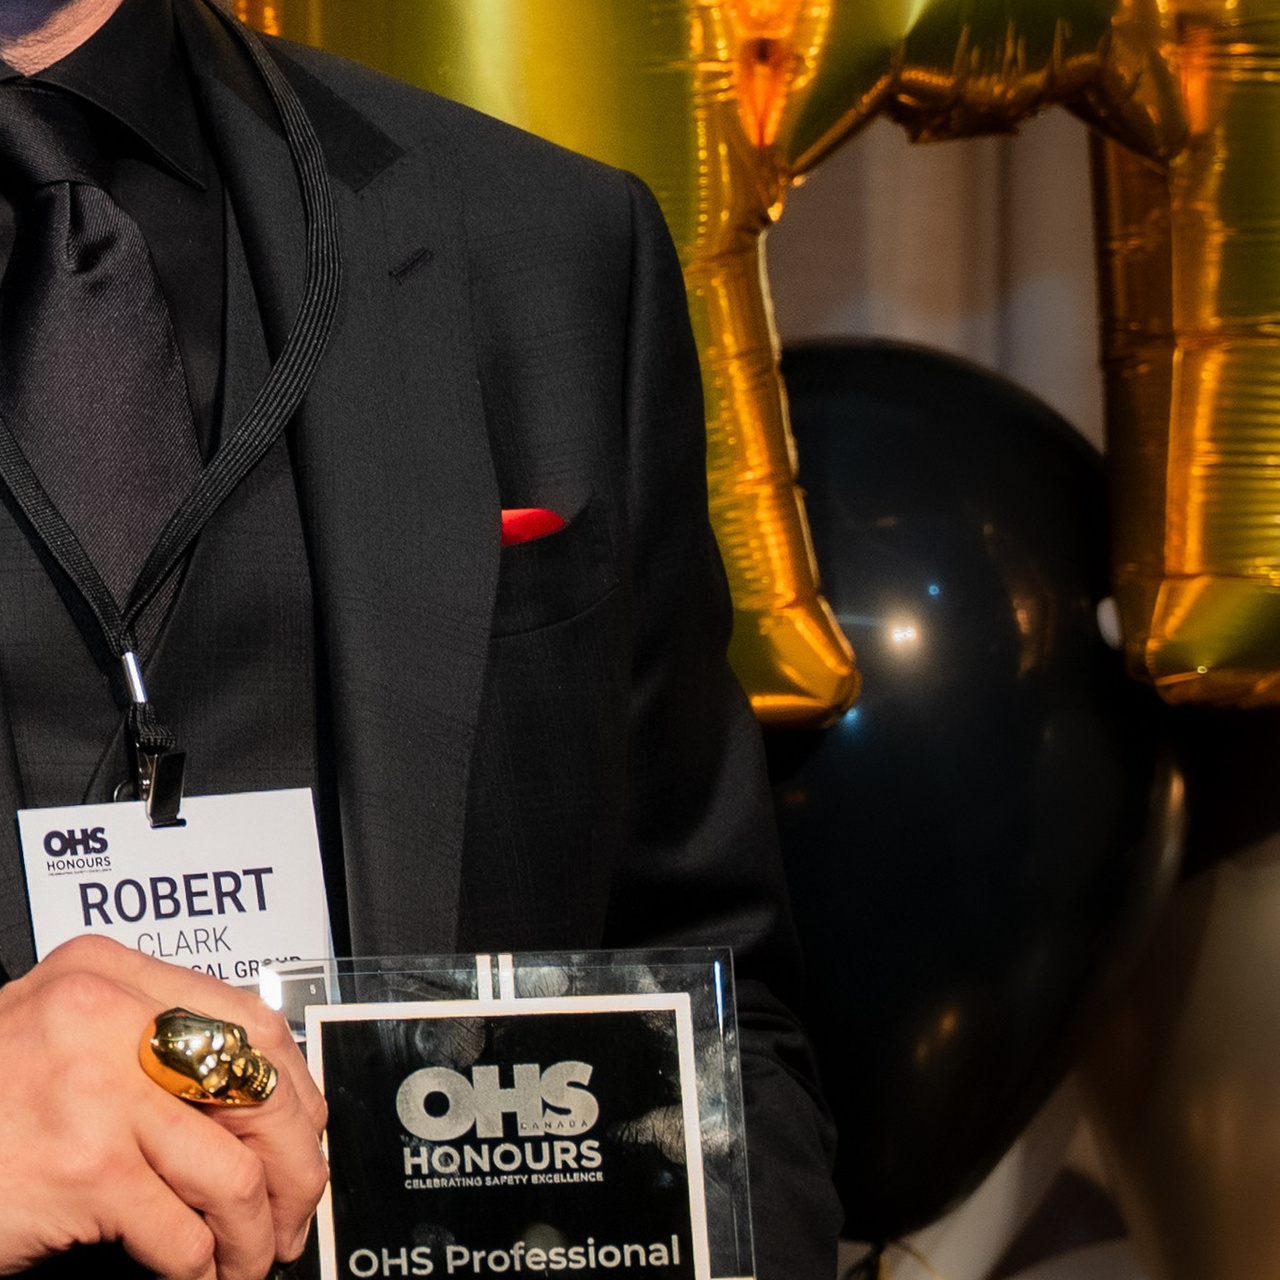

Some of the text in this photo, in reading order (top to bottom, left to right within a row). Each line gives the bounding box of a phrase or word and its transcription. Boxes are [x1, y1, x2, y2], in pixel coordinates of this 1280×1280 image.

[43, 826, 109, 858] OHS
[46, 856, 112, 872] HONOURS
[78, 866, 274, 927] ROBERT
[137, 925, 233, 958] CLARK
[396, 1060, 600, 1142] OHS
[520, 1119, 589, 1132] CANADA
[403, 1139, 603, 1175] HONOURS
[404, 1171, 604, 1190] CELEBRATING SAFETY EXCELLENCE
[348, 1234, 680, 1278] OHS Professional
